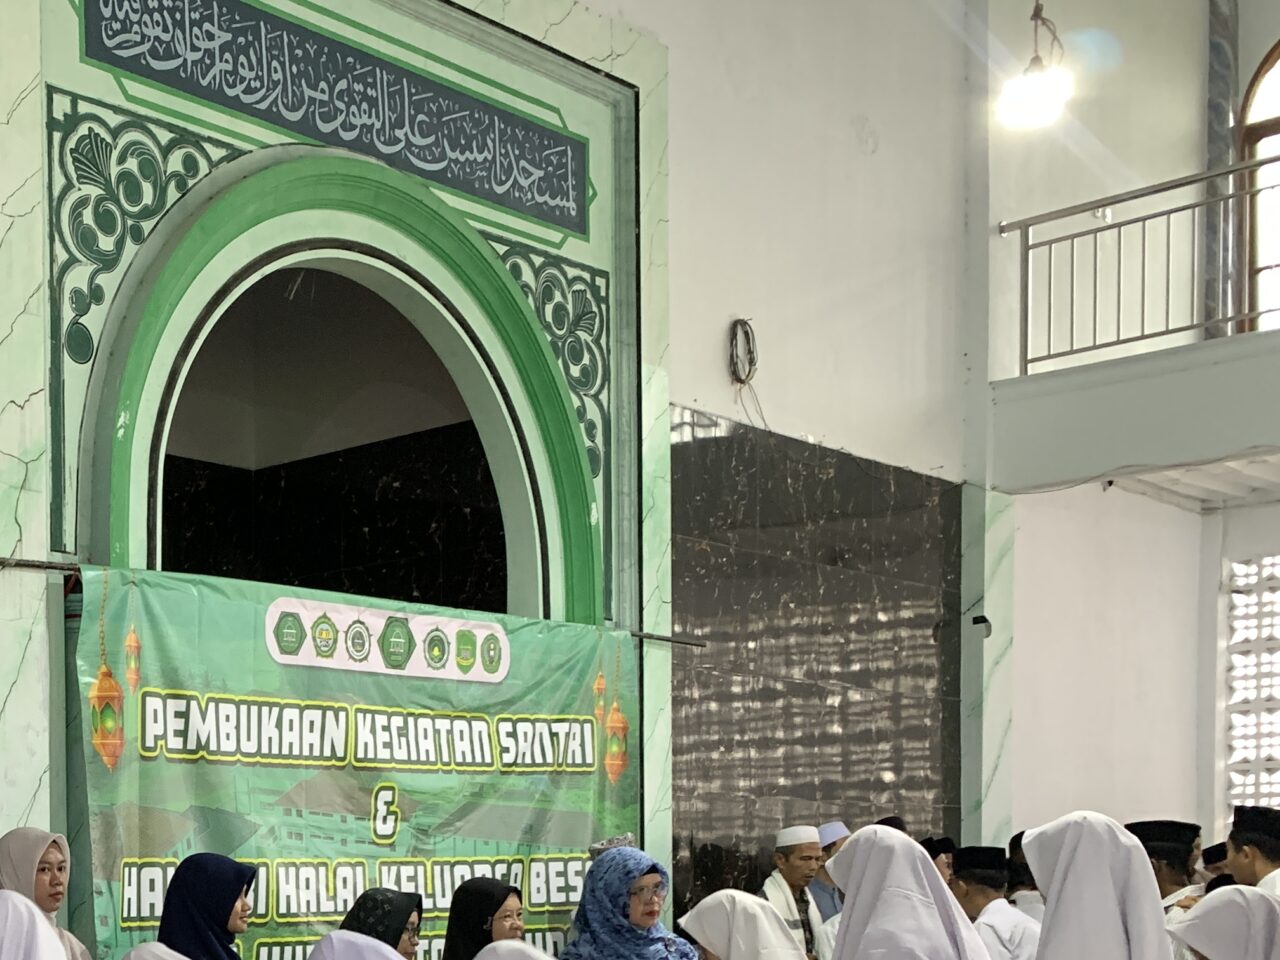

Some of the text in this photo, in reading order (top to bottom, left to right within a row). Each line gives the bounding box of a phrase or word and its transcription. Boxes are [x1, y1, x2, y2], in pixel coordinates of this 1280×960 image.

[145, 697, 592, 764] PEMBUKAAN KEGIATAN SANTRI
[375, 790, 397, 835] &
[381, 861, 524, 909] KELUA
